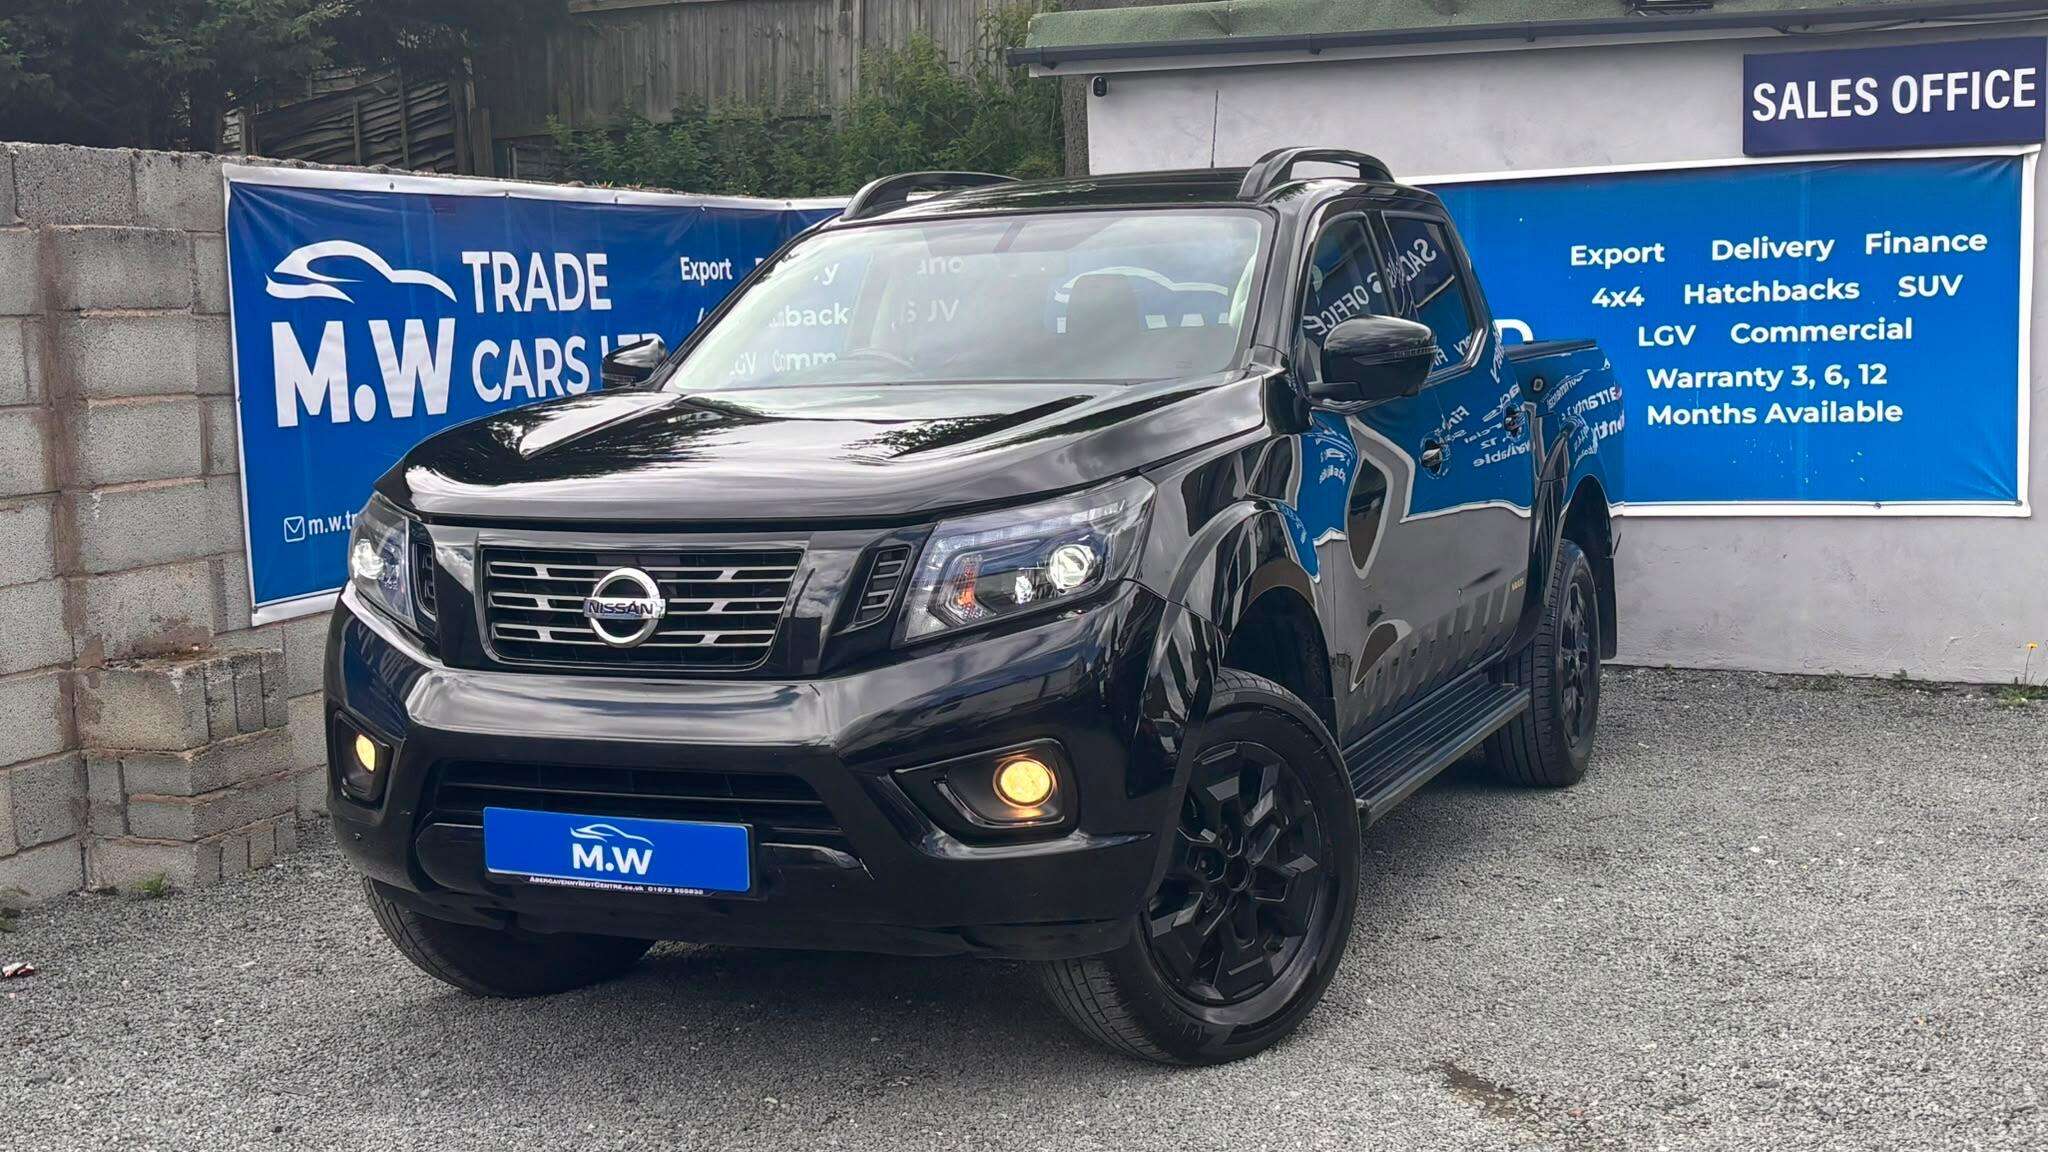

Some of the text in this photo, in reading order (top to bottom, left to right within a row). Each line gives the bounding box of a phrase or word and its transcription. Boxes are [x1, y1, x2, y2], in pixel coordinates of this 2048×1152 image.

[1752, 67, 2036, 122] SALES OFFICE
[1571, 231, 1988, 269] Export Delivery Finance
[462, 252, 612, 313] TRADE
[680, 256, 733, 286] Export
[1592, 274, 1964, 308] 4x4 Hatchbacks SUV
[1638, 317, 1912, 347] LGV Commercial
[271, 317, 456, 428] M.W
[472, 336, 591, 402] CARS
[1647, 363, 1887, 392] Warranty 3, 6, 12
[1647, 399, 1903, 425] Months Available
[588, 601, 654, 615] NISSAN
[571, 843, 652, 875] M.W
